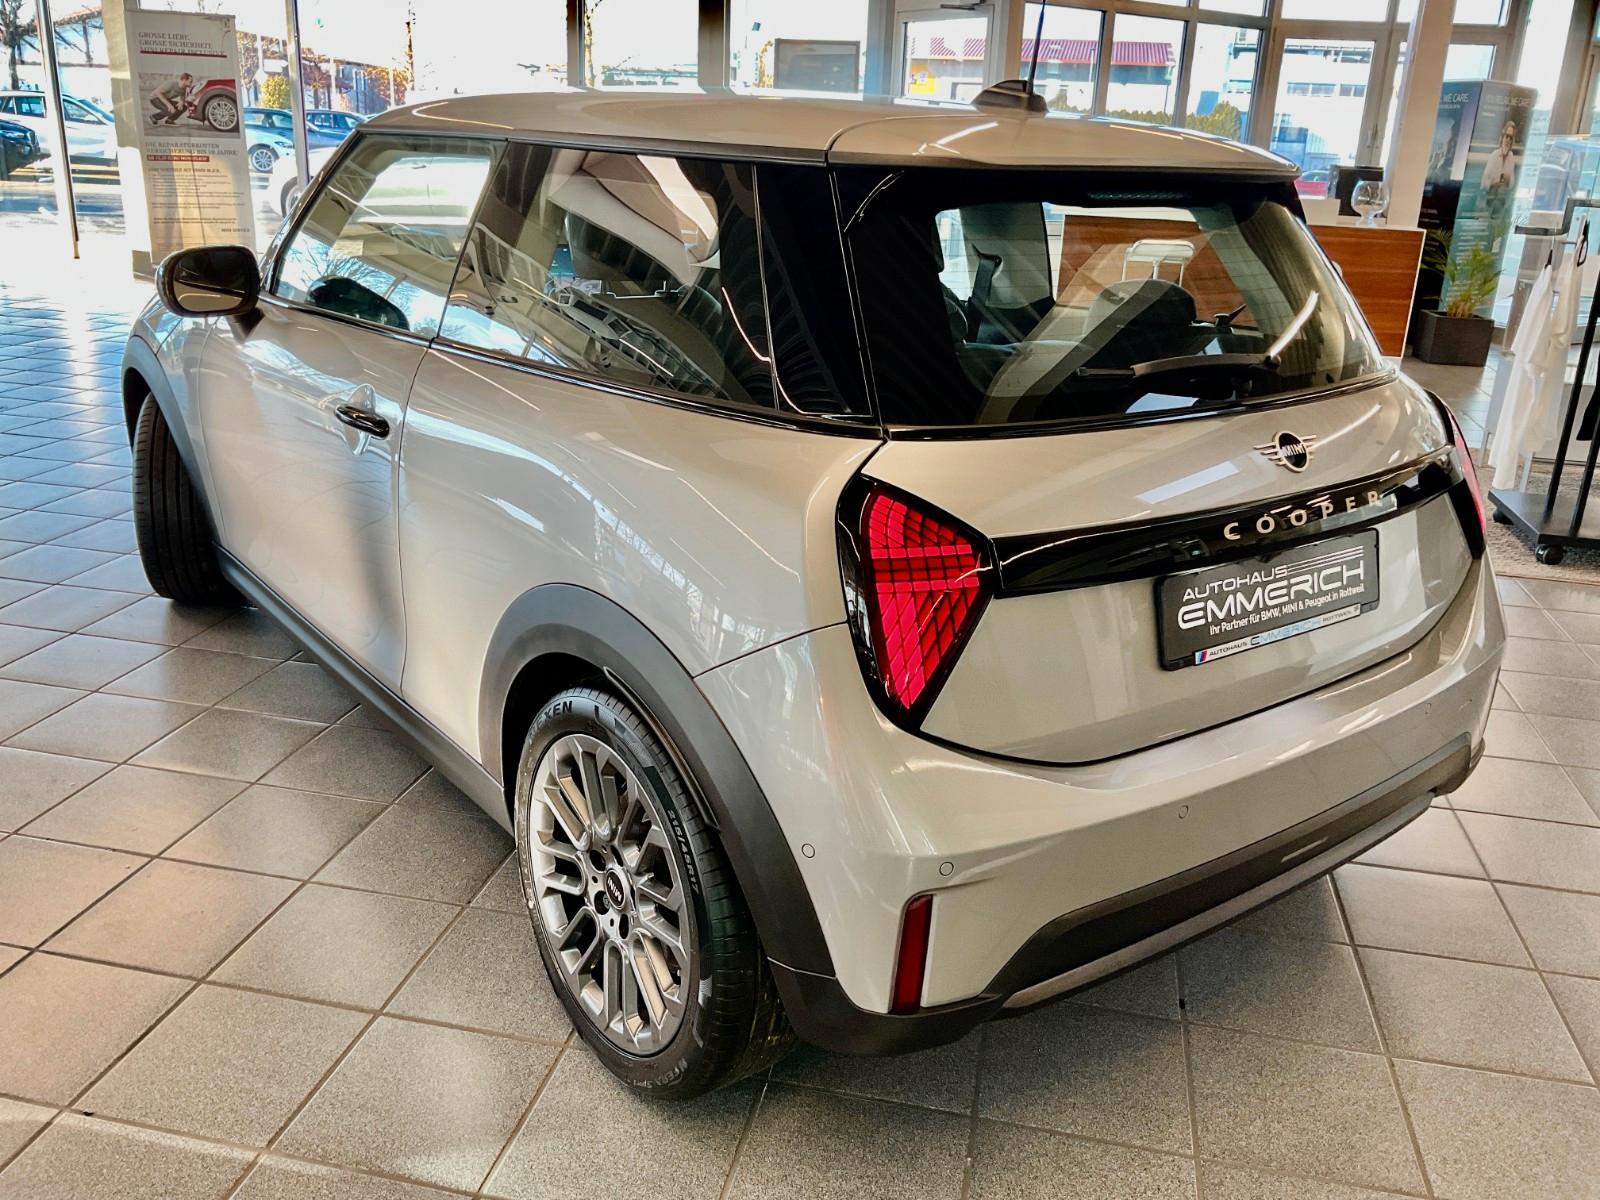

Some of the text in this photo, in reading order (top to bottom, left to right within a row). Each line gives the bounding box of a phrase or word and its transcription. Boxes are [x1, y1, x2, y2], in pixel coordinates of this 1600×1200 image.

[1282, 443, 1306, 457] MINI
[1223, 490, 1380, 541] COOPER
[1178, 559, 1364, 629] EMMERICH
[1182, 565, 1288, 602] AUTOHAUS
[1209, 582, 1365, 636] Ihr Partner für BMW, MINI & Peugeot in Rottweil
[1209, 640, 1248, 656] AUTOHAUS
[1250, 617, 1321, 645] EMMERICH
